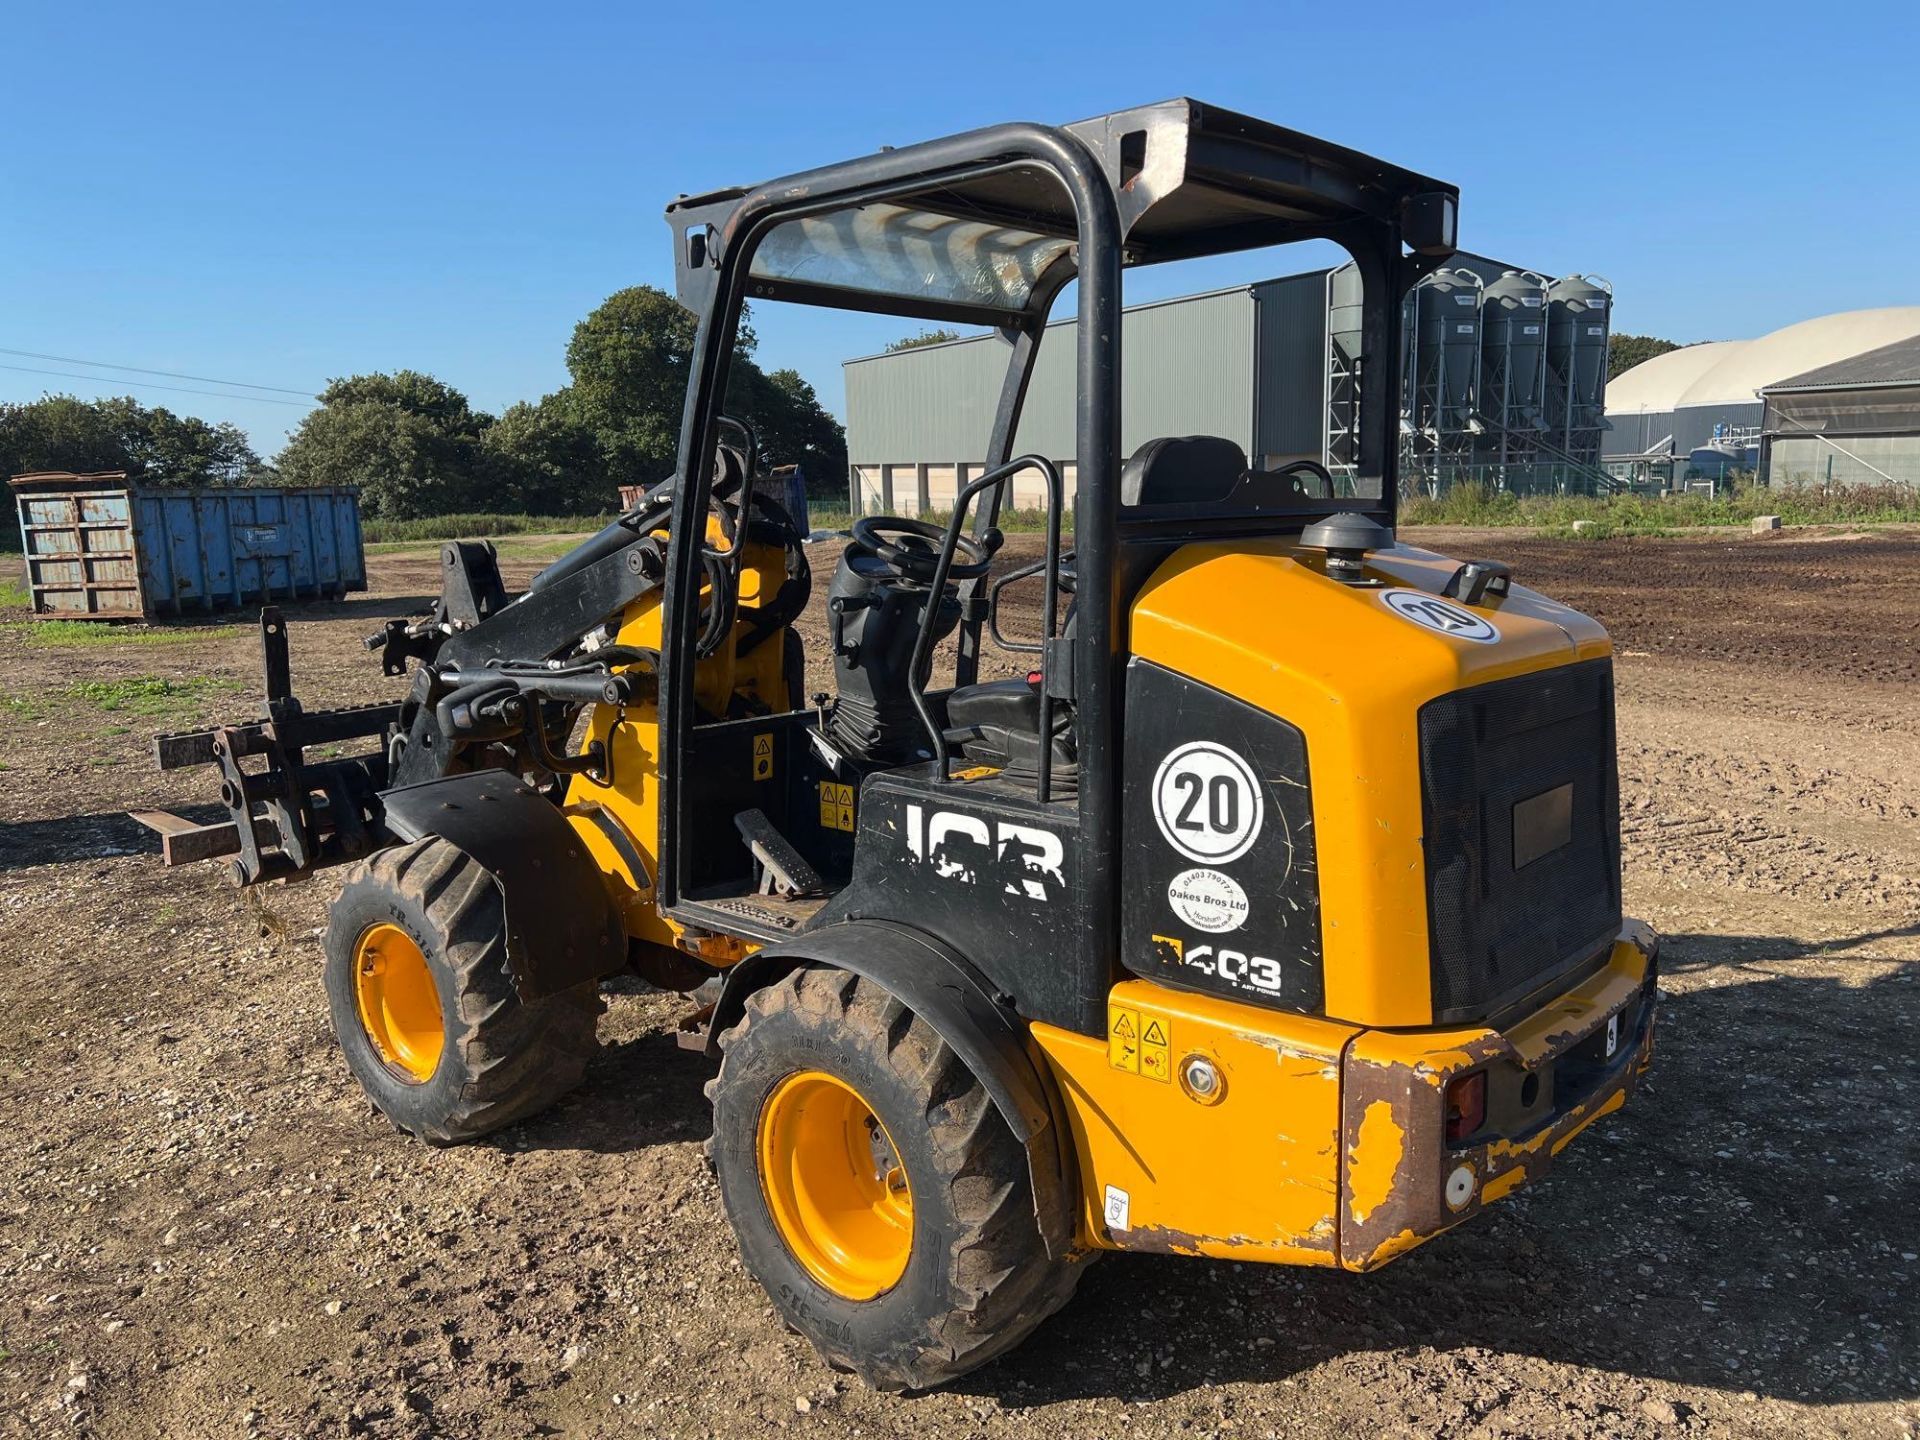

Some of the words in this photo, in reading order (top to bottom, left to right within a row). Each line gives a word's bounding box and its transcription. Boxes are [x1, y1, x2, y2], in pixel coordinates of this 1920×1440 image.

[1401, 600, 1477, 630] 20
[1175, 771, 1239, 835] 20
[1183, 871, 1205, 887] 01403
[1206, 872, 1234, 895] 790777
[1169, 888, 1201, 902] Oakes
[1203, 895, 1227, 907] Bros
[1230, 899, 1247, 911] Ltd
[1185, 945, 1282, 990] 403
[1256, 986, 1281, 998] POWER
